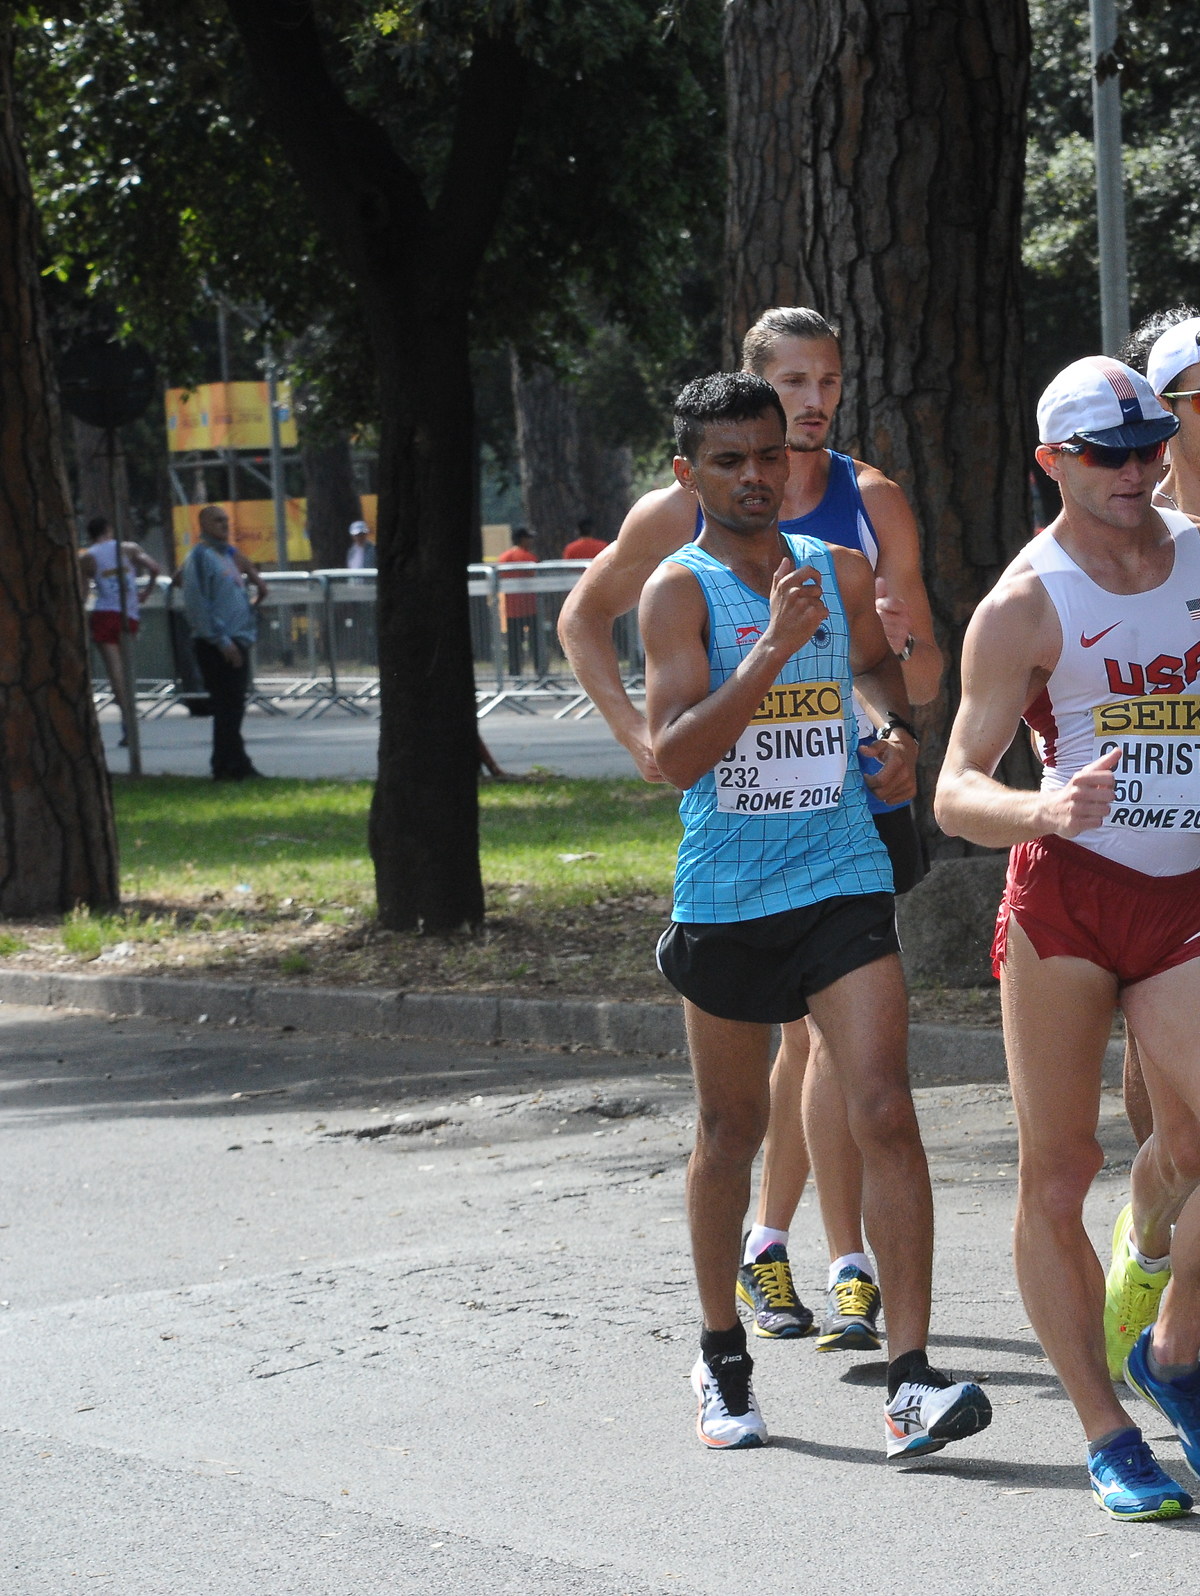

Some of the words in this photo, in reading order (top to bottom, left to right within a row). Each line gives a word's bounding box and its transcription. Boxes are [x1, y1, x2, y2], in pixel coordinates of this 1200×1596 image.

[751, 687, 841, 720] EIKO
[756, 725, 844, 761] SINGH
[719, 766, 760, 789] 232
[735, 789, 796, 812] ROME
[798, 785, 841, 808] 2016
[1113, 779, 1143, 804] 50
[1110, 807, 1179, 829] ROME
